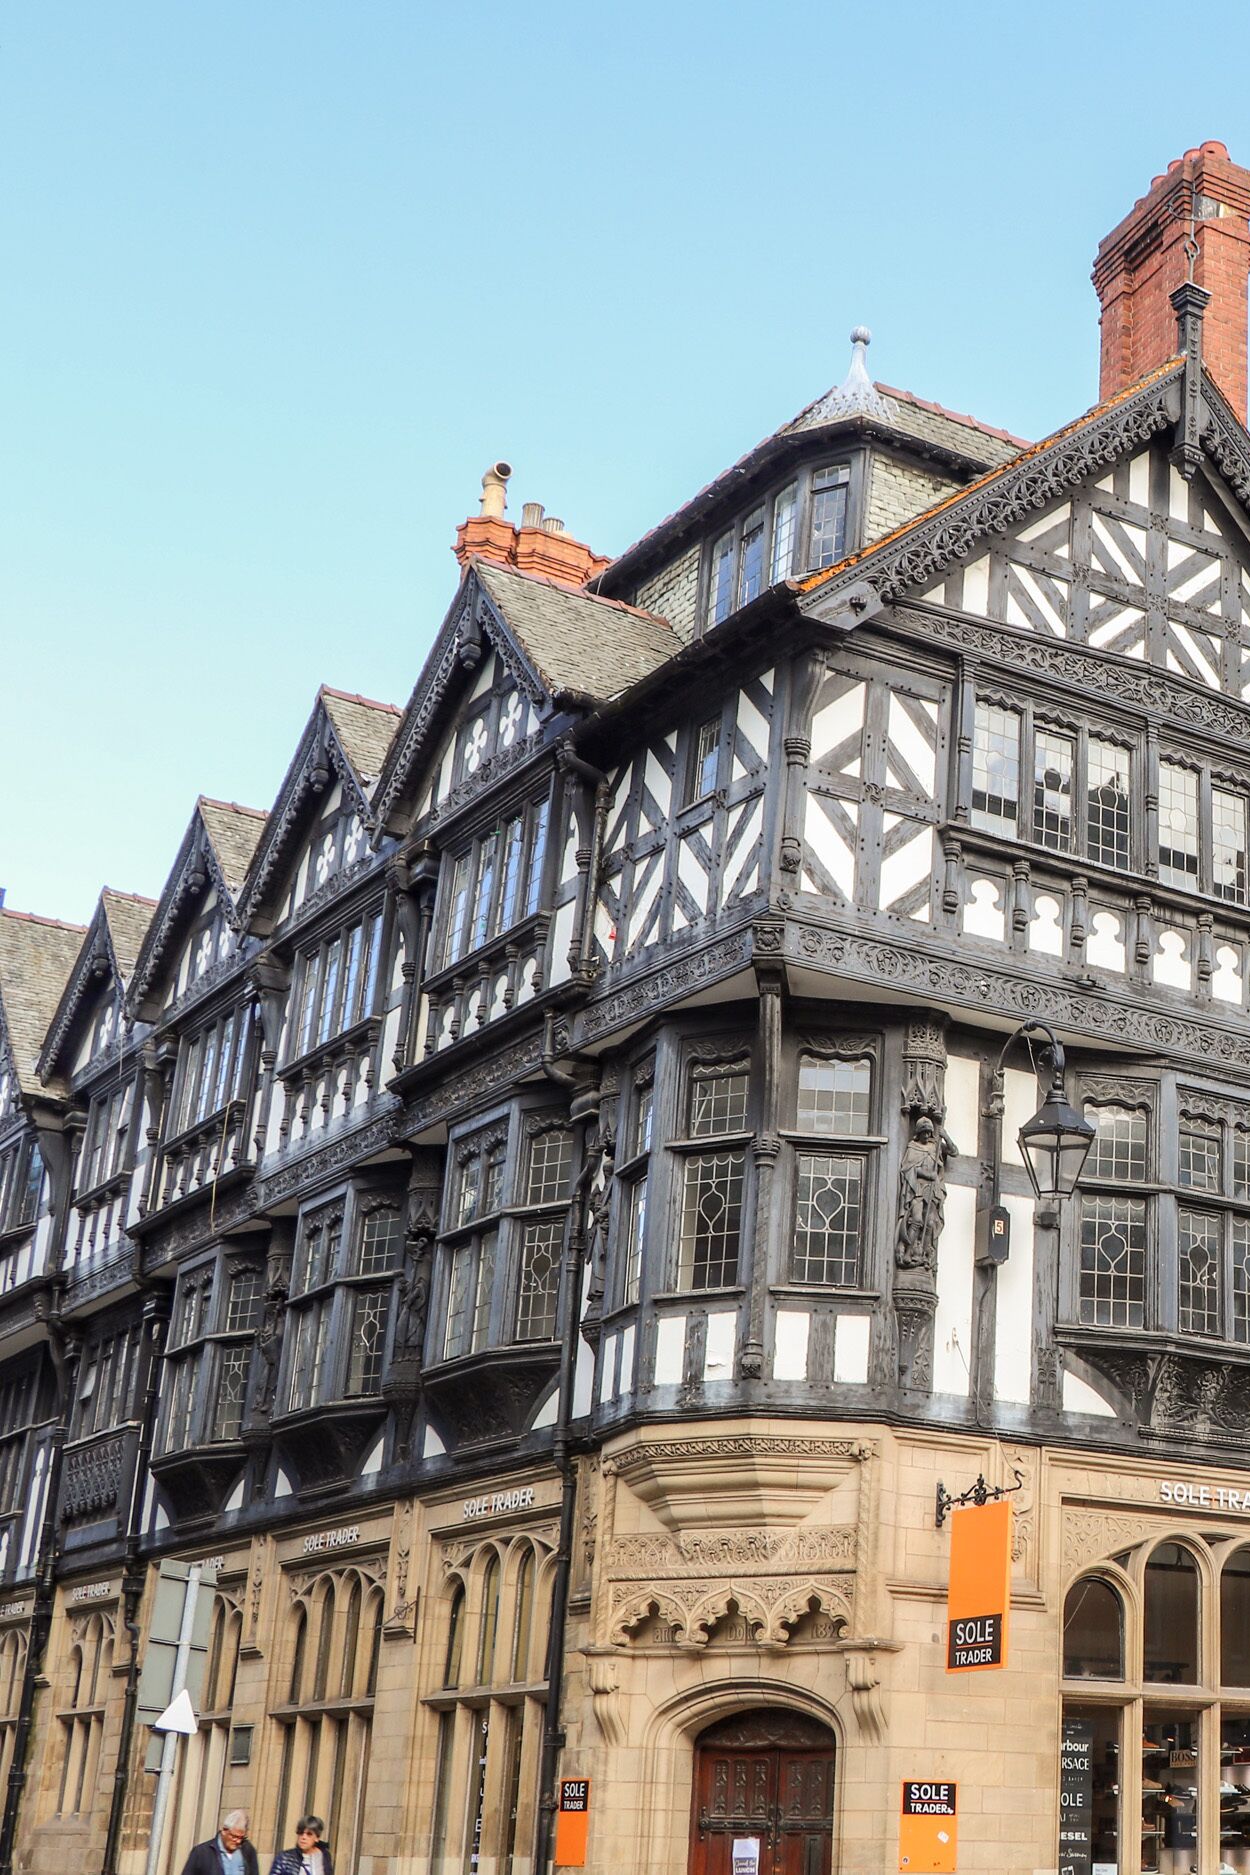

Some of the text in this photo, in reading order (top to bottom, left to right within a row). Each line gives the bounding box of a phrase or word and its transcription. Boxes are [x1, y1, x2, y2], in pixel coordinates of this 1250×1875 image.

[996, 1221, 1003, 1233] 5
[1160, 1481, 1210, 1506] SOLE
[463, 1488, 534, 1519] SOLE TRADER
[303, 1526, 360, 1552] SOLE TRADER
[202, 1556, 224, 1570] RADER
[955, 1619, 994, 1645] SOLE
[955, 1648, 993, 1666] TRADER
[1061, 1739, 1089, 1752] rbour
[1062, 1757, 1090, 1771] RSACE
[564, 1783, 586, 1798] SOLE
[910, 1784, 949, 1800] SOLE
[563, 1801, 584, 1810] TRADER
[1060, 1792, 1083, 1807] OLE
[910, 1803, 948, 1814] TRADER
[1060, 1832, 1088, 1841] ESEL
